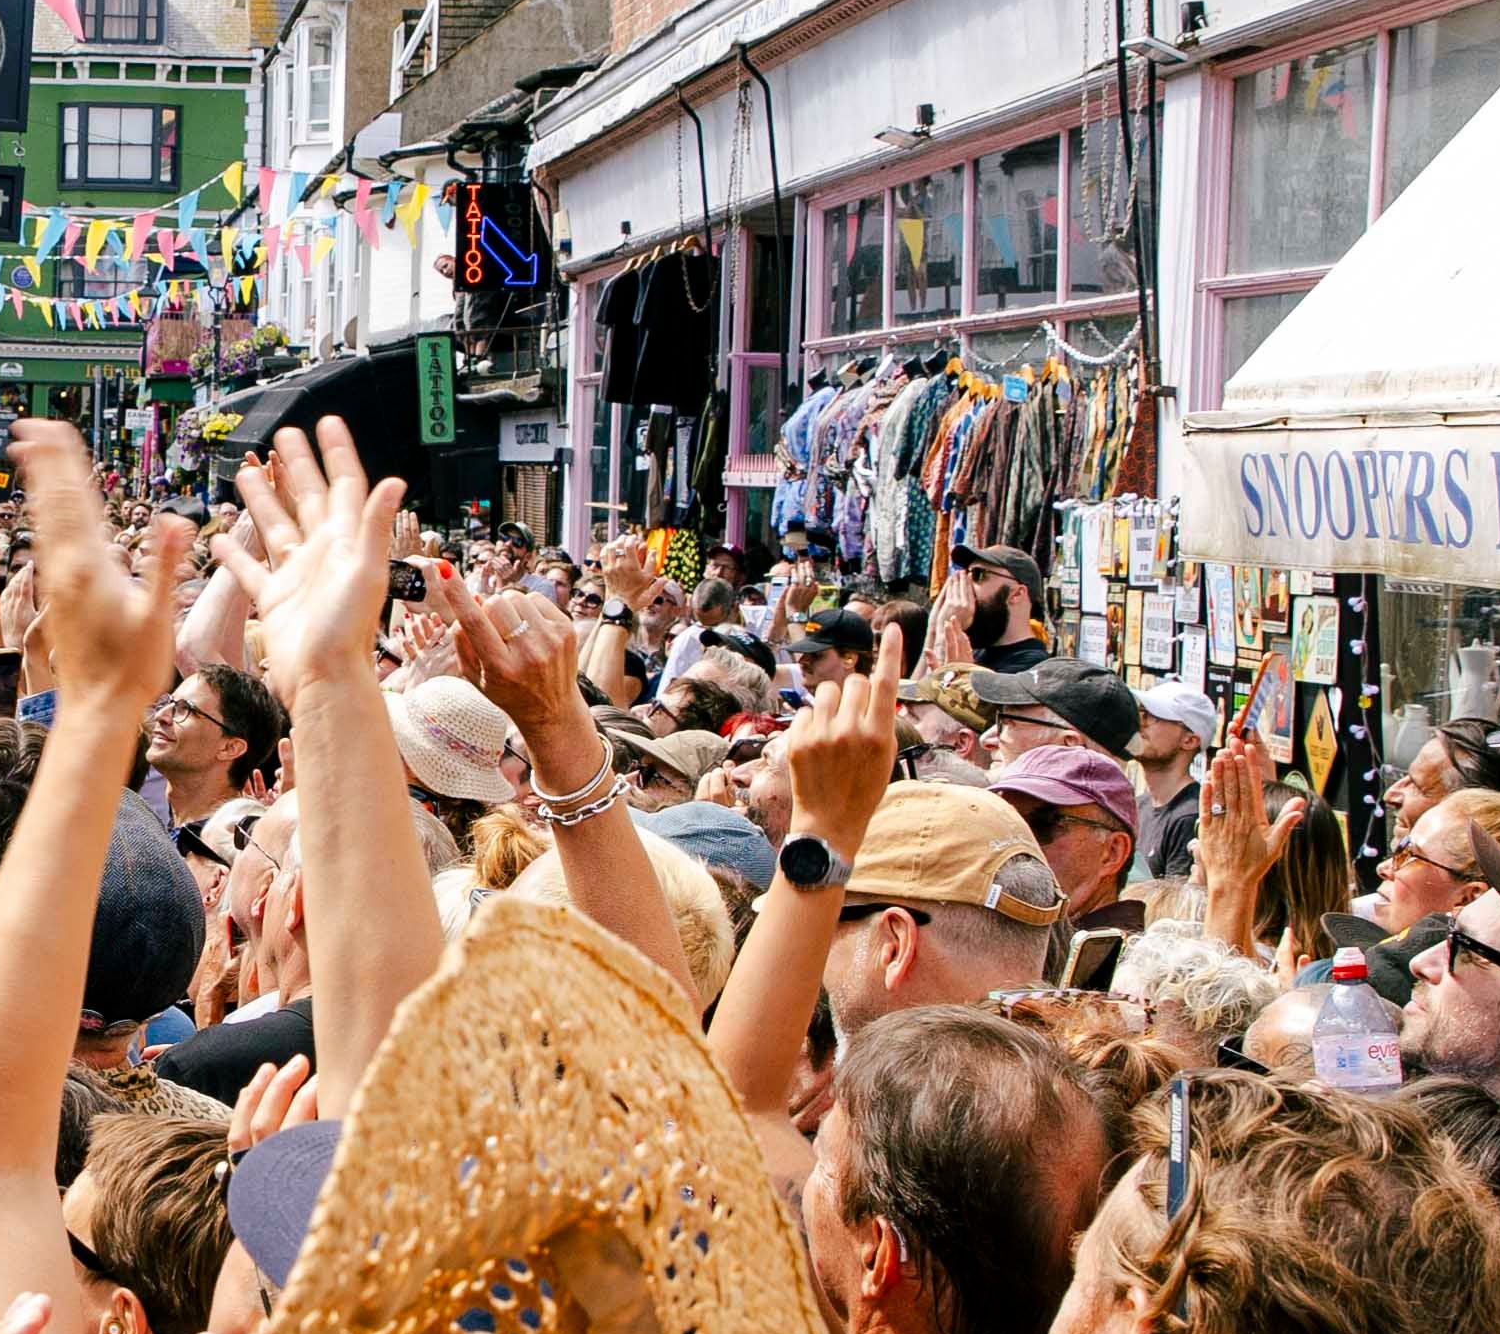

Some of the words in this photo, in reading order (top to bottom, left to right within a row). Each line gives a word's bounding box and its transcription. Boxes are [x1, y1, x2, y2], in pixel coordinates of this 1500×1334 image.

[465, 184, 482, 284] TATTOO
[427, 342, 446, 438] TATTOO
[1240, 448, 1474, 549] SNOOPERS
[1368, 1043, 1400, 1060] evia
